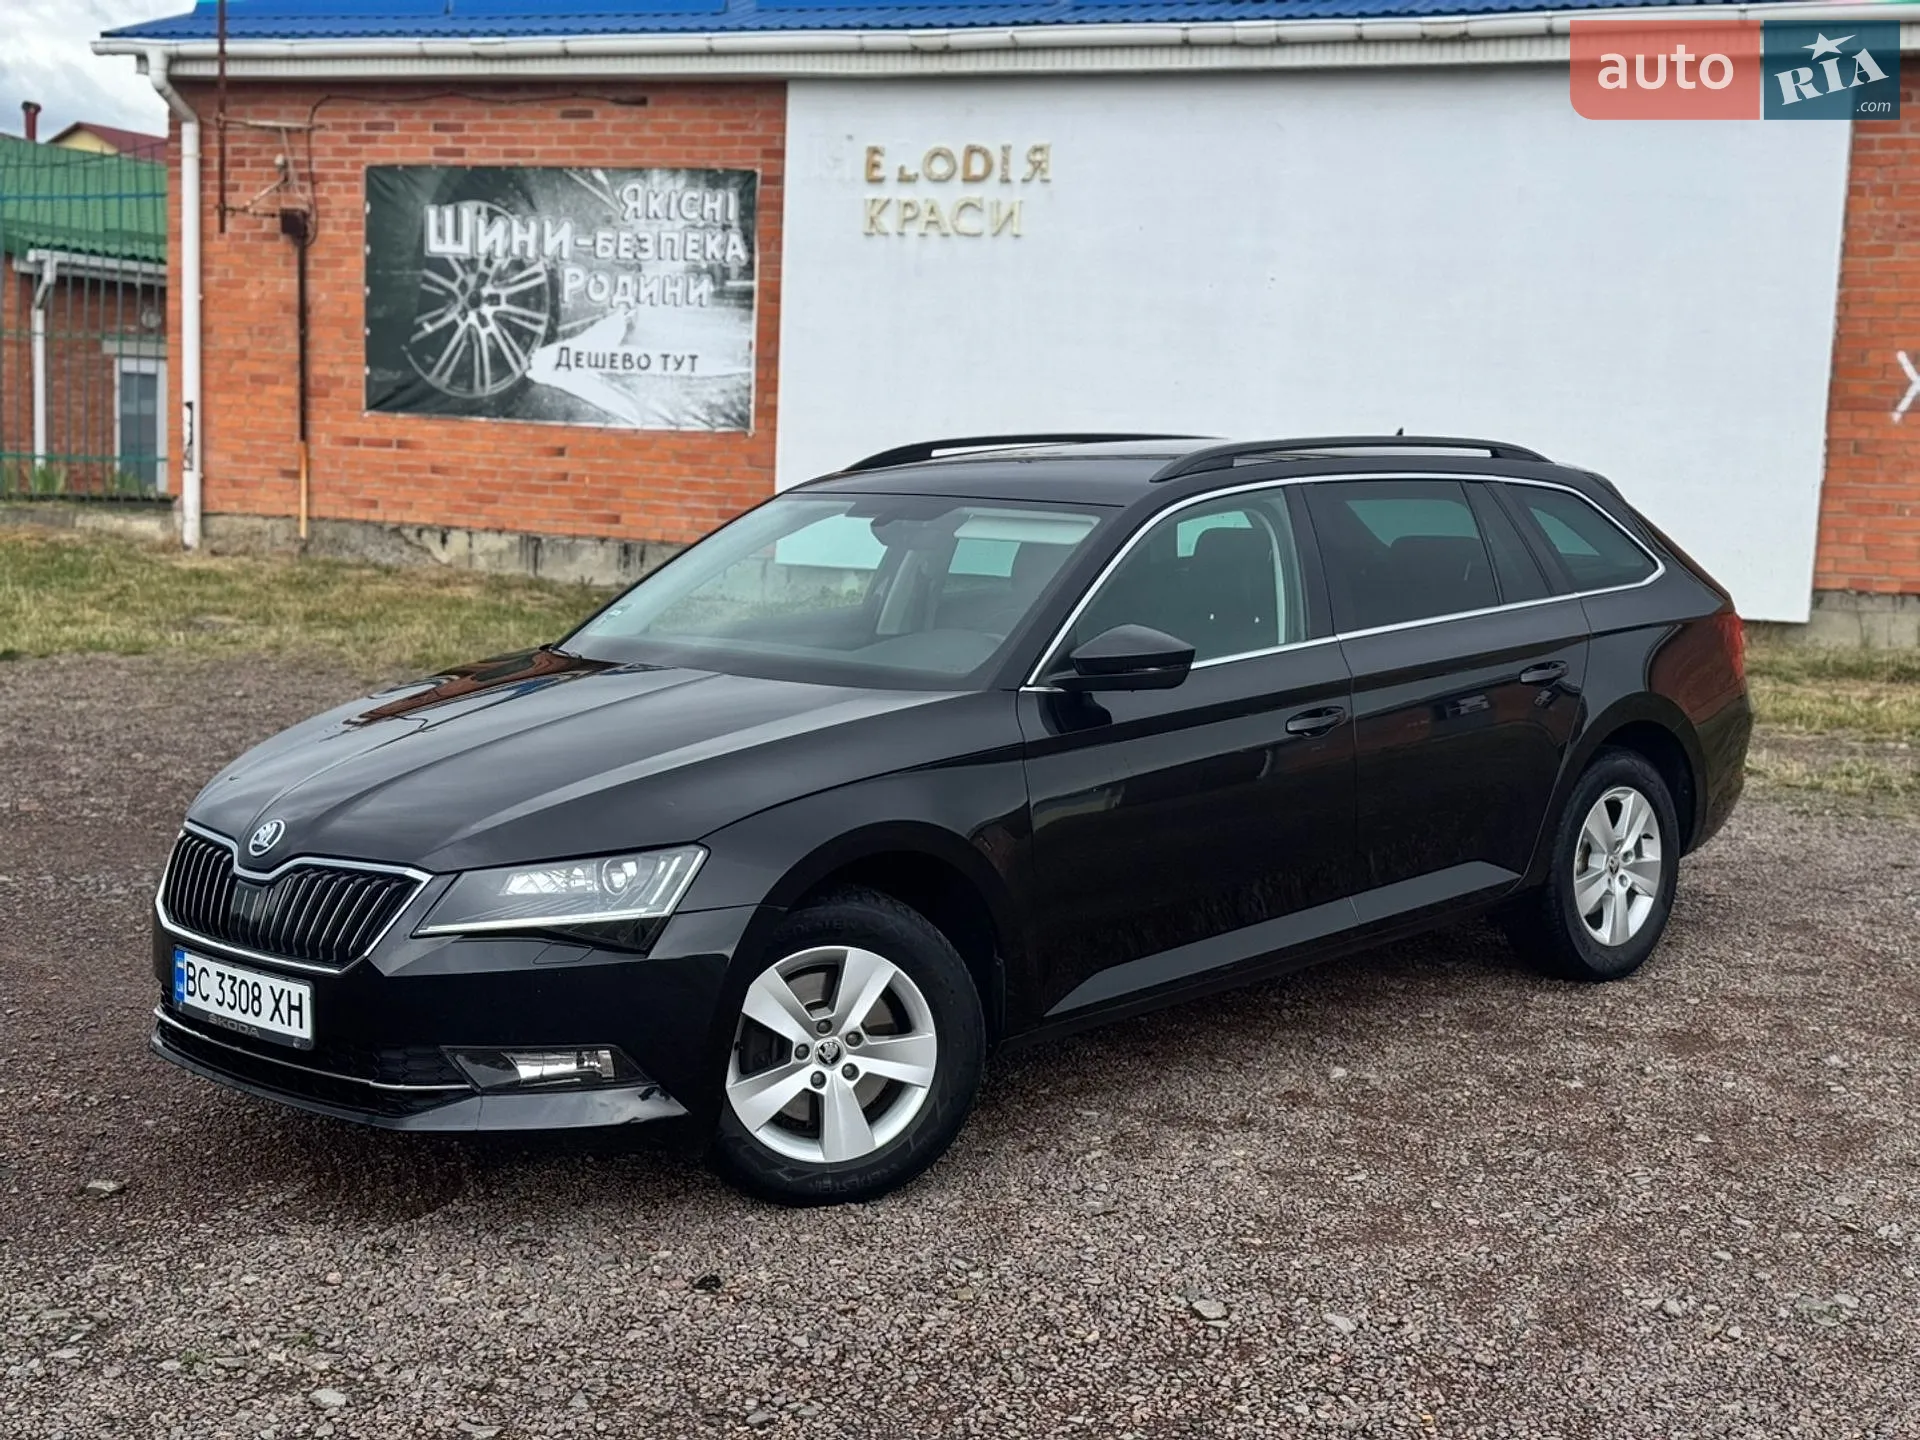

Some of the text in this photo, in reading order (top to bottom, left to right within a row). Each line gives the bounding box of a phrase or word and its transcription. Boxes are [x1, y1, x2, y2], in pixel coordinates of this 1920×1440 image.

[863, 196, 1023, 238] КРАСИ
[660, 353, 699, 373] ТУТ
[186, 961, 304, 1030] BC 3308 XH
